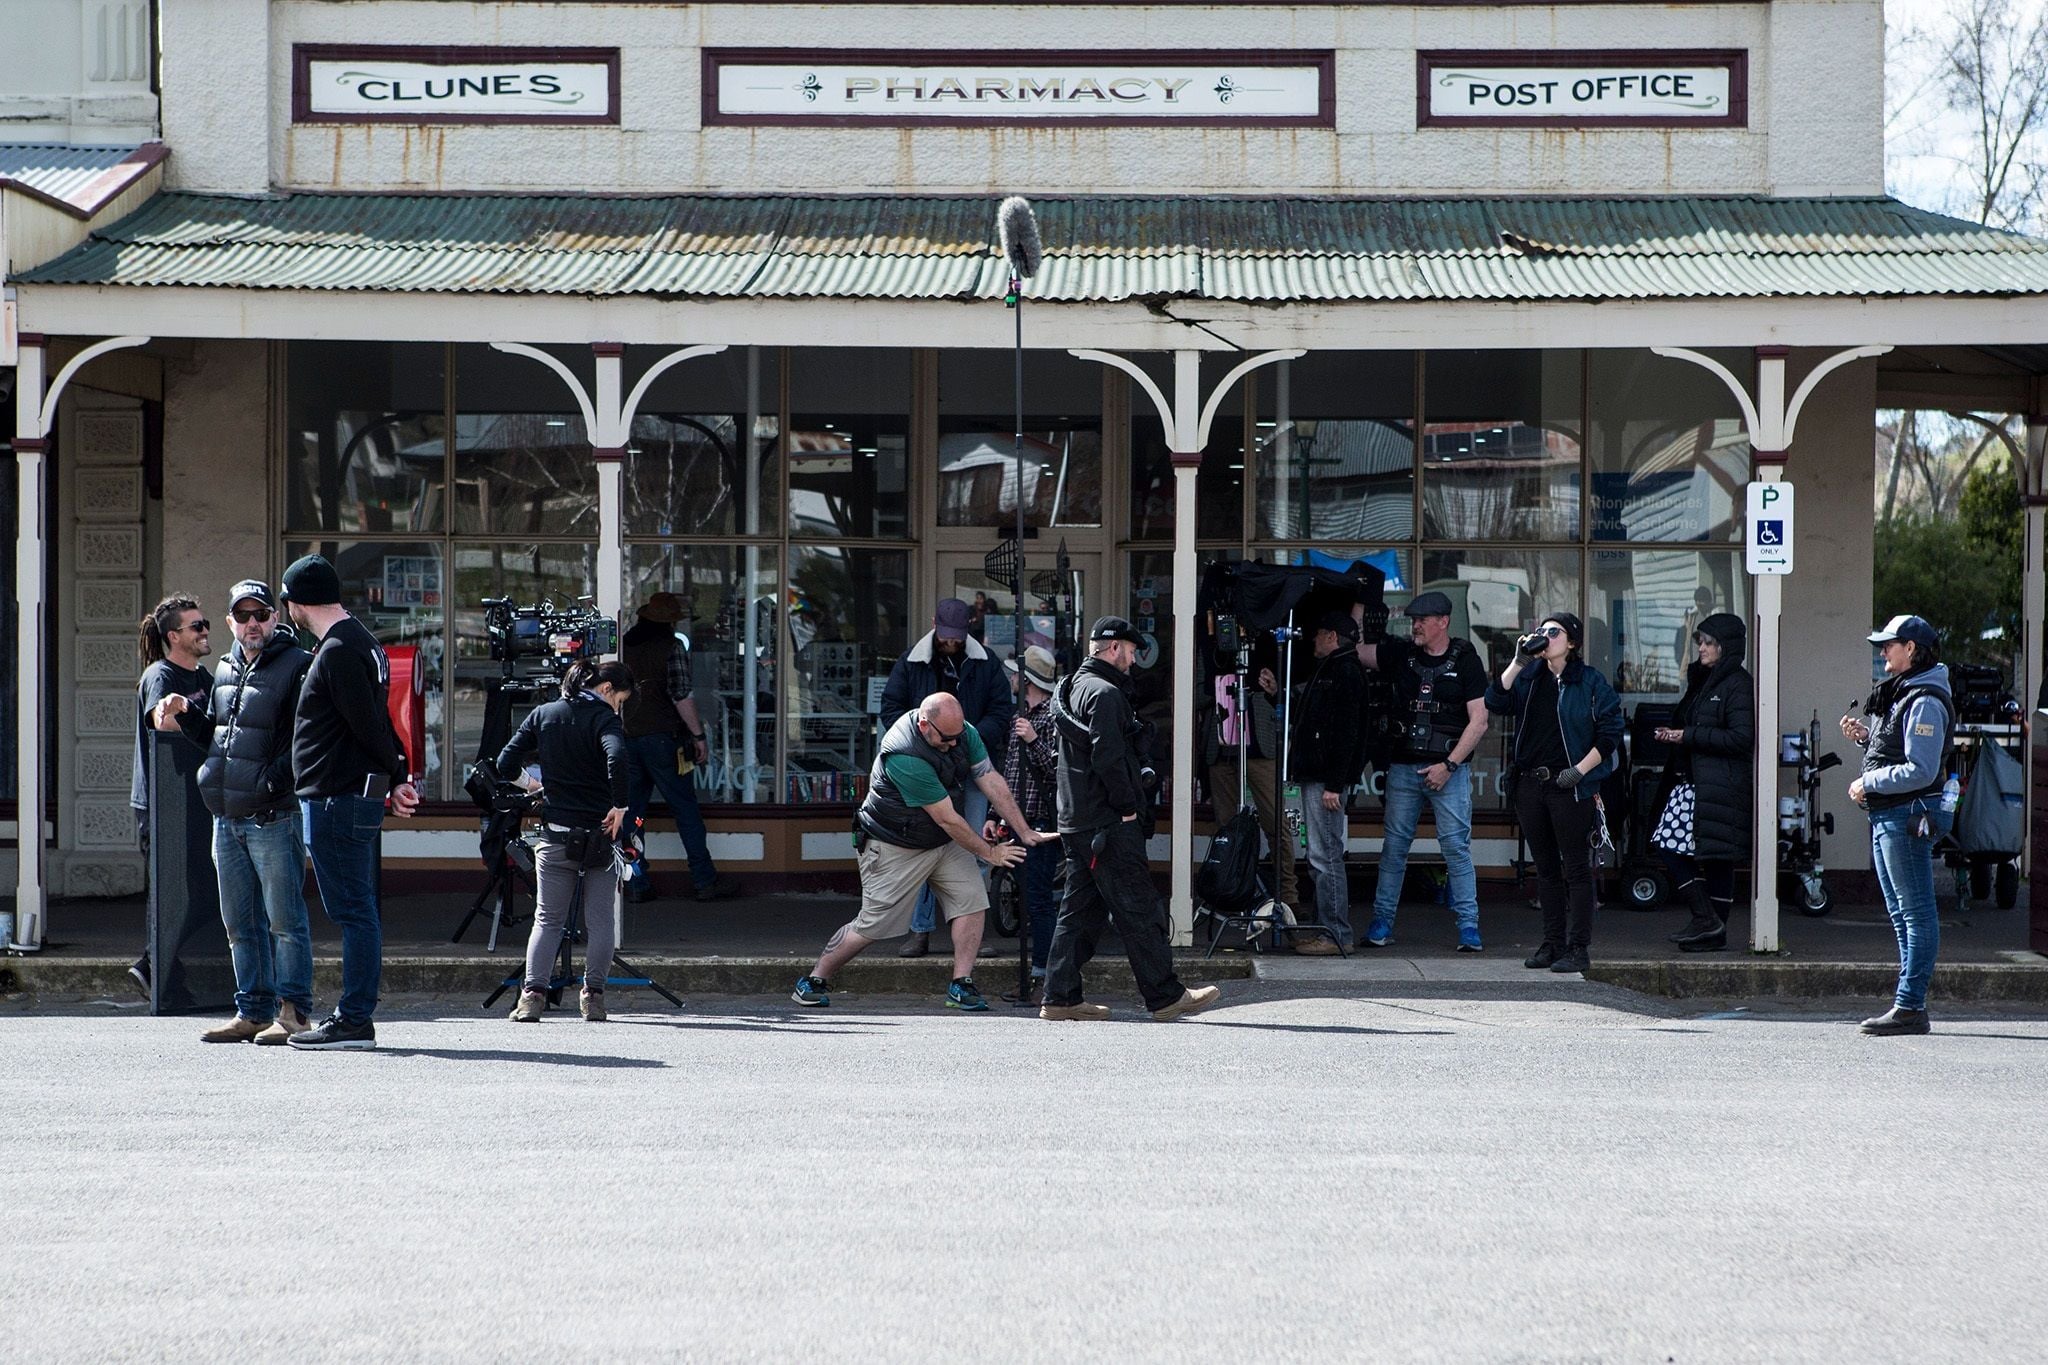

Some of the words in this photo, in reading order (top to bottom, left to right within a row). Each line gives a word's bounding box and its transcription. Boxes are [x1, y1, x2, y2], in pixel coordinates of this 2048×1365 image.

[357, 74, 562, 101] CLUNES
[844, 76, 1193, 103] PHARMACY
[1468, 81, 1559, 106] POST
[1571, 74, 1694, 102] OFFICE
[1762, 489, 1780, 510] P
[1591, 515, 1635, 530] ervices
[693, 764, 762, 790] MACY
